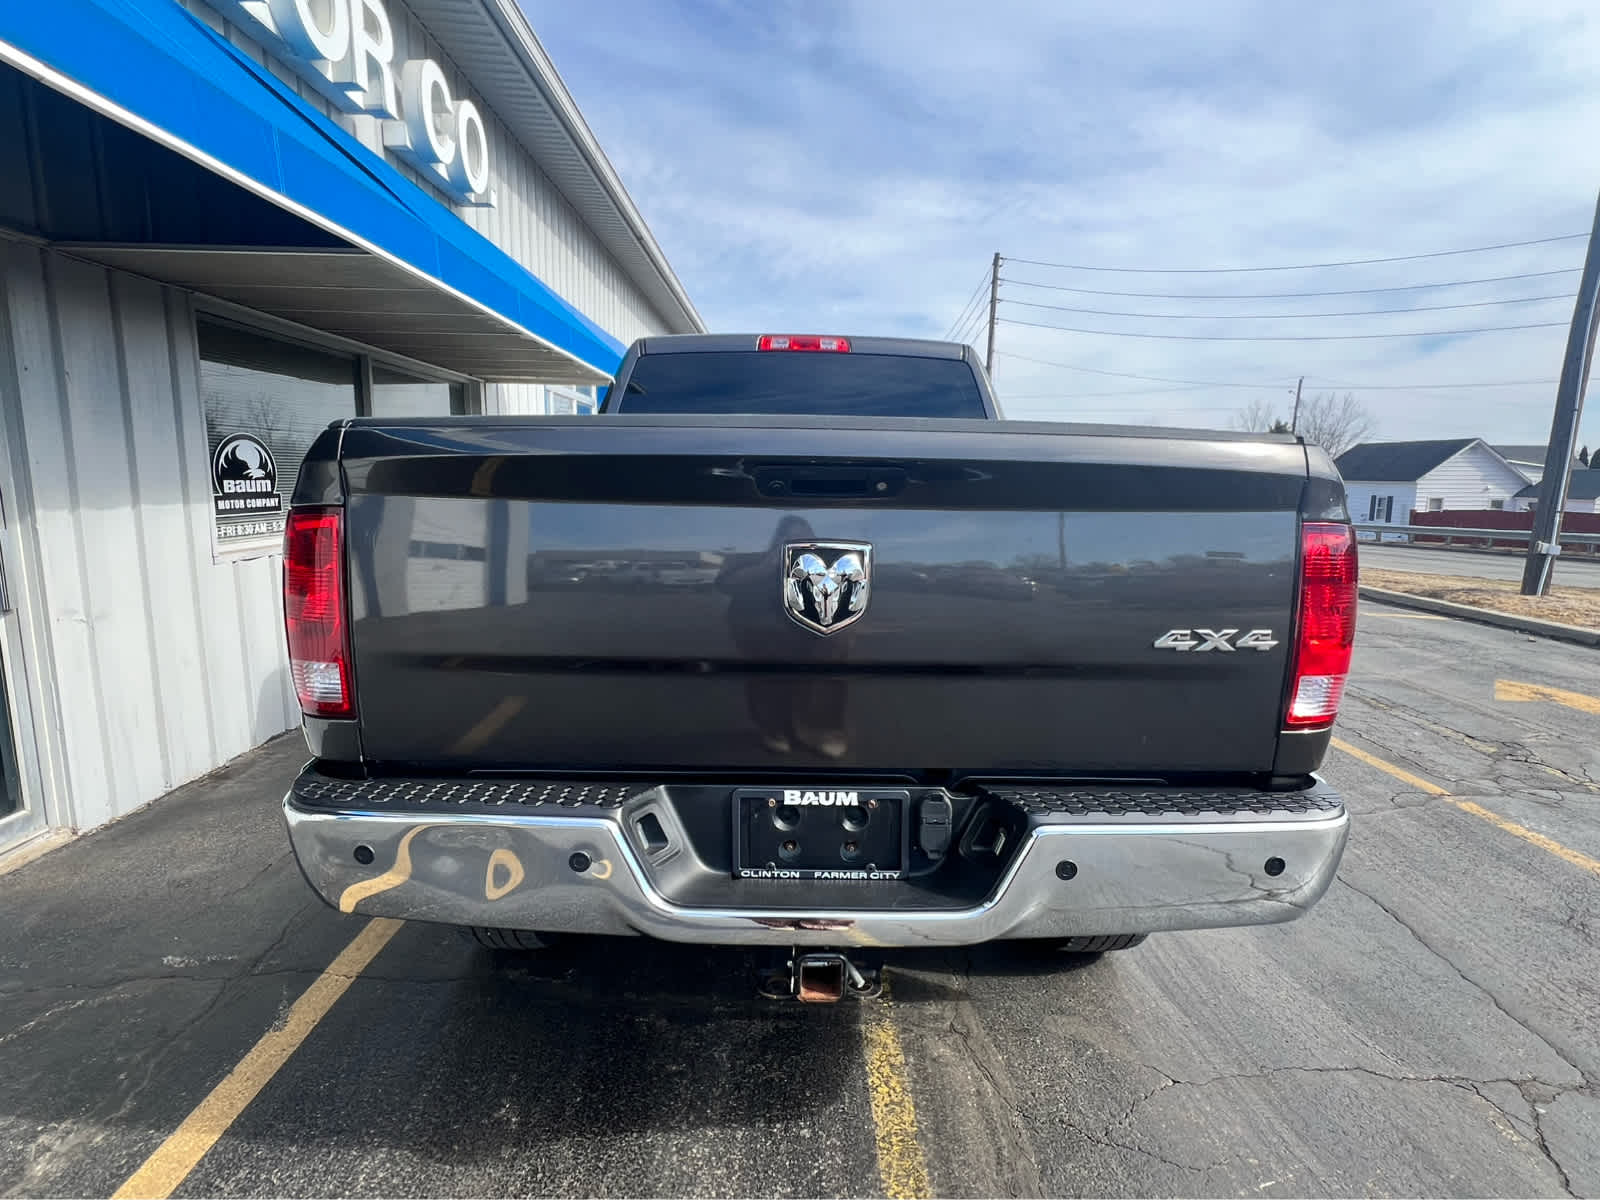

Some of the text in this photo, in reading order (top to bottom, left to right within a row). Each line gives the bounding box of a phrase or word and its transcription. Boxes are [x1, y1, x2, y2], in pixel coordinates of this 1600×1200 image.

[217, 498, 279, 509] MOTOR COMPANY
[216, 525, 236, 537] -FRI
[783, 790, 859, 806] BAUM
[741, 869, 900, 880] CLINTON FARMER CITY
